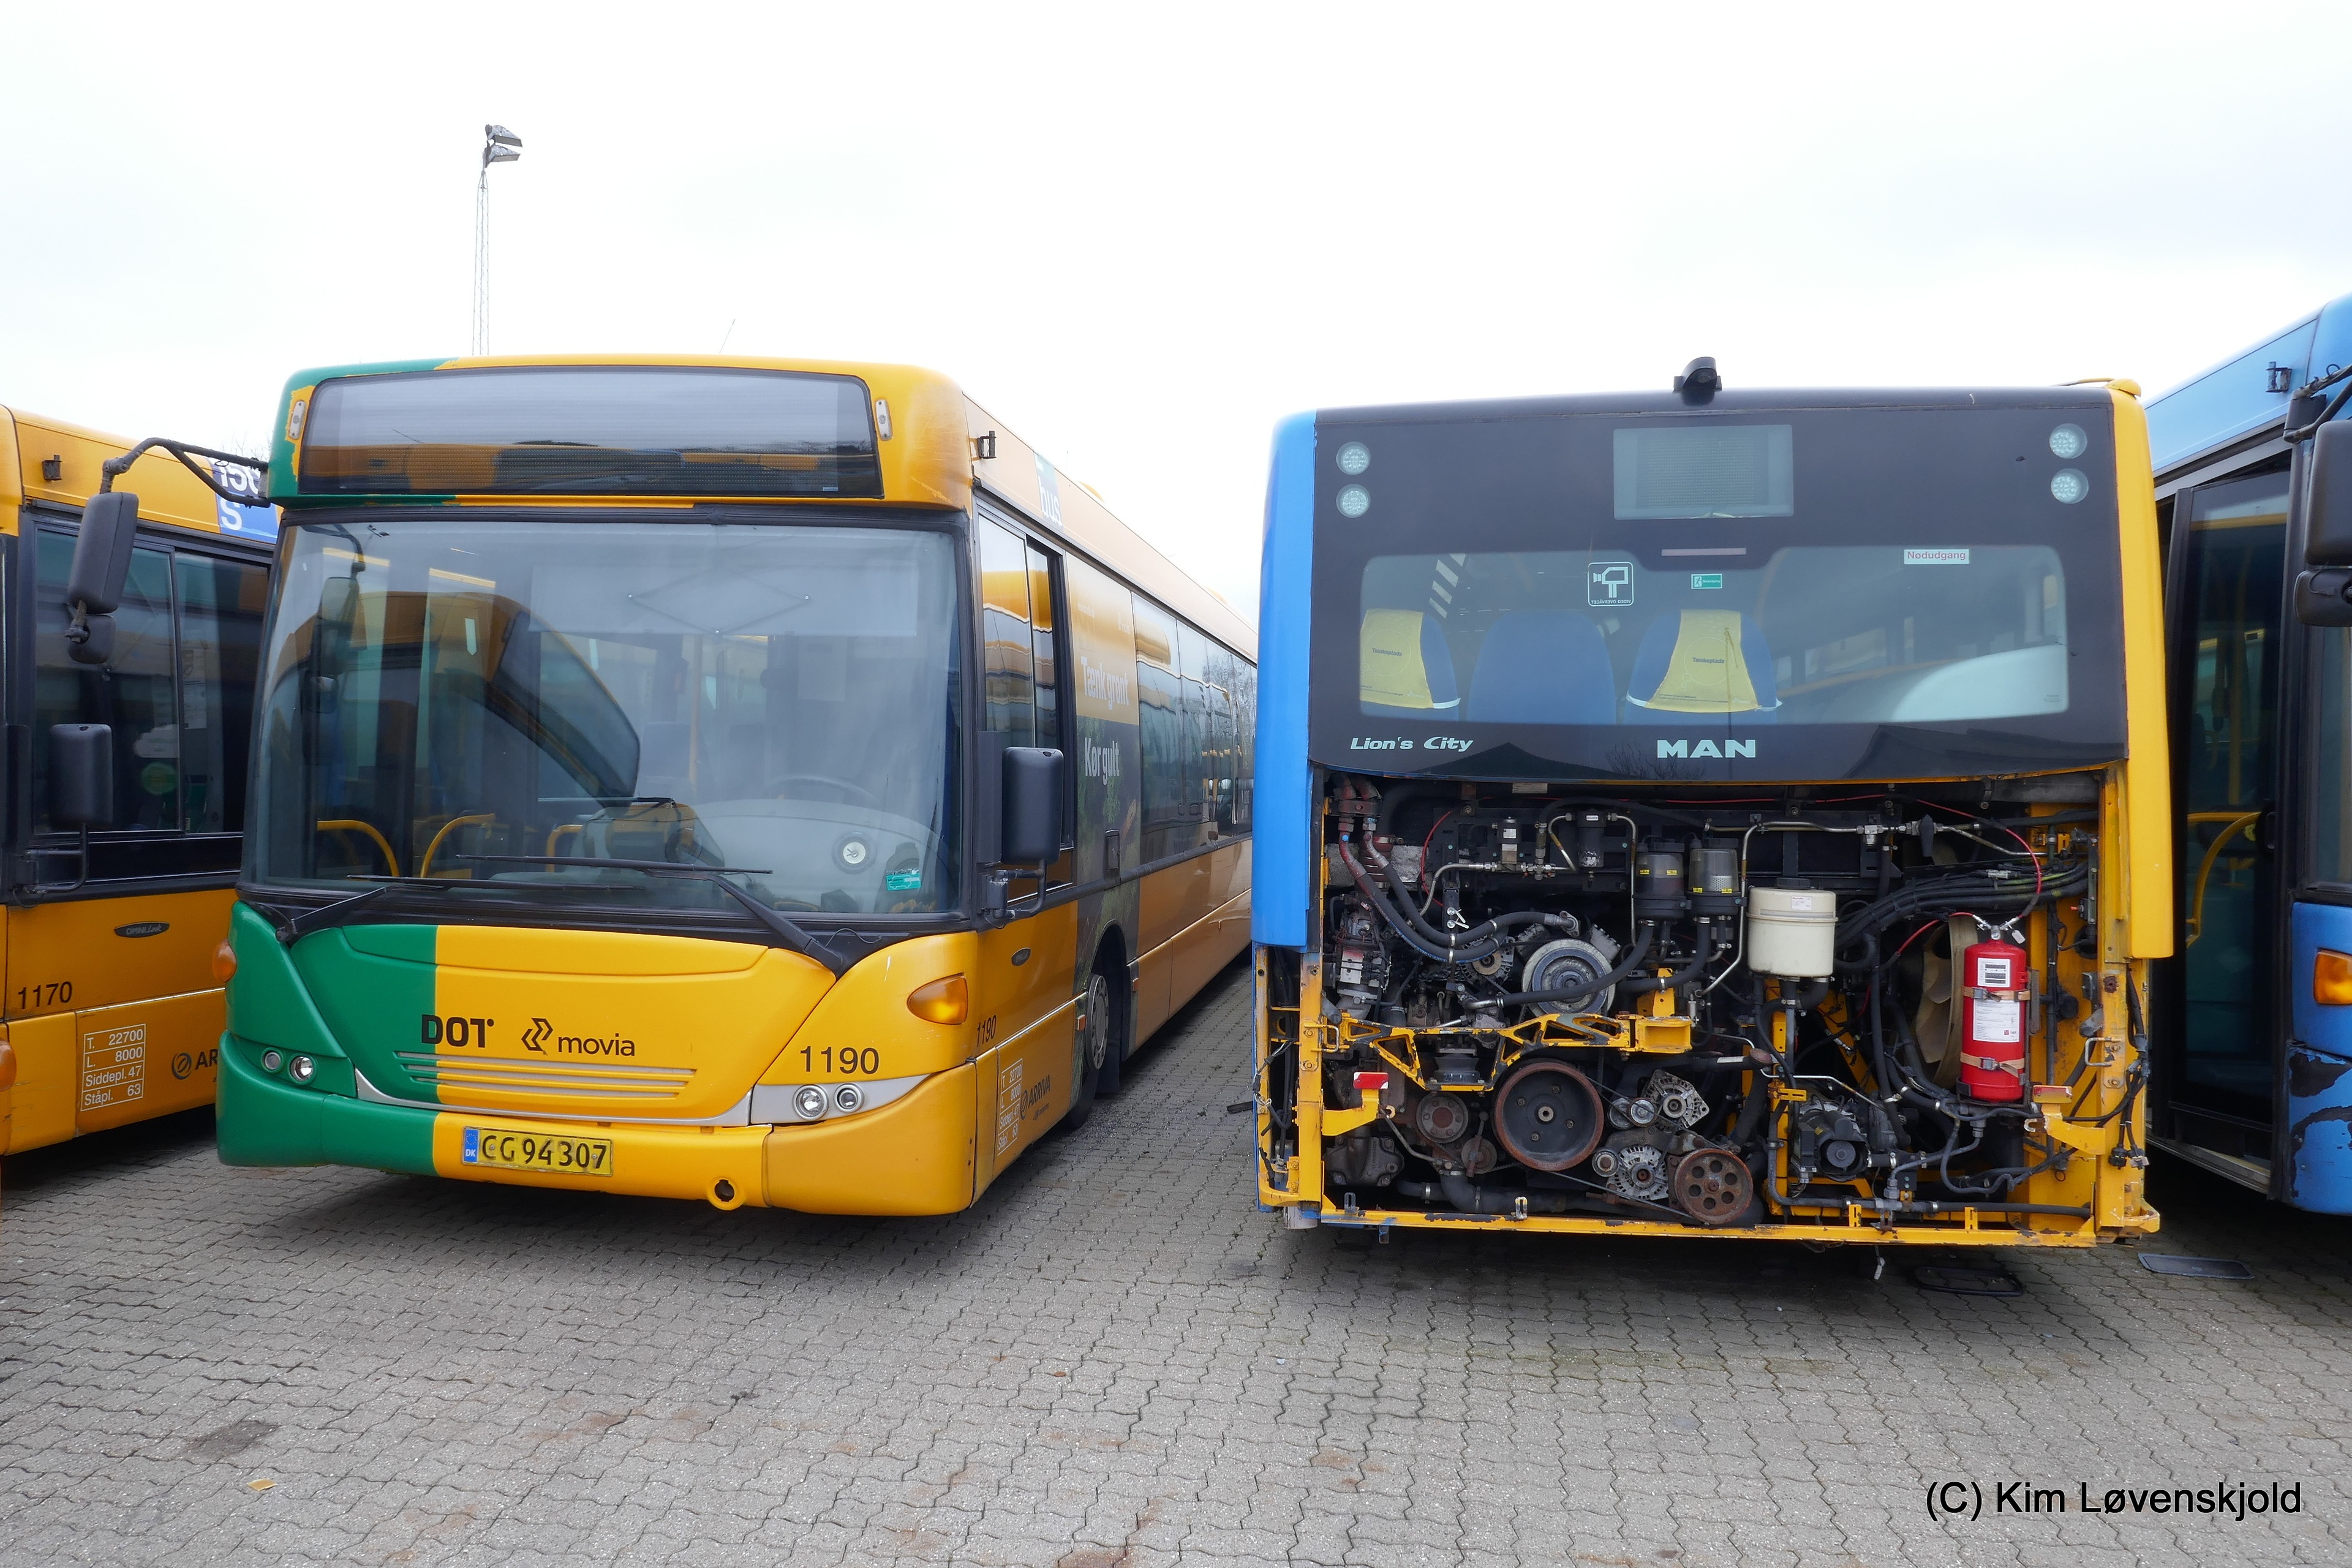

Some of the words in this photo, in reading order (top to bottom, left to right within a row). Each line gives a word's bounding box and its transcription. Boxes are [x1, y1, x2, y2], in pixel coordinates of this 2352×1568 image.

[1038, 476, 1063, 527] bus
[1907, 551, 1966, 560] Nødudgang
[1081, 657, 1107, 701] Tænk
[1107, 673, 1129, 711] grønt
[1423, 737, 1474, 752] City
[1657, 740, 1756, 758] MAN
[1085, 737, 1101, 777] Kør
[1102, 741, 1120, 786] gult
[18, 981, 73, 1009] 1170
[87, 1038, 95, 1049] T.
[108, 1029, 143, 1046] 22700
[421, 1014, 488, 1048] DOT
[977, 1014, 997, 1047] 1190
[558, 1033, 636, 1057] movia
[86, 1057, 96, 1068] L.
[115, 1047, 143, 1062] 8000
[800, 1046, 880, 1074] 1190
[86, 1068, 127, 1087] Siddepl.
[128, 1065, 143, 1078] 47
[1009, 1065, 1022, 1084] 22700
[85, 1089, 113, 1106] Ståpl.
[127, 1084, 141, 1096] 63
[1028, 1074, 1050, 1109] ARRIVA
[466, 1148, 476, 1158] DK
